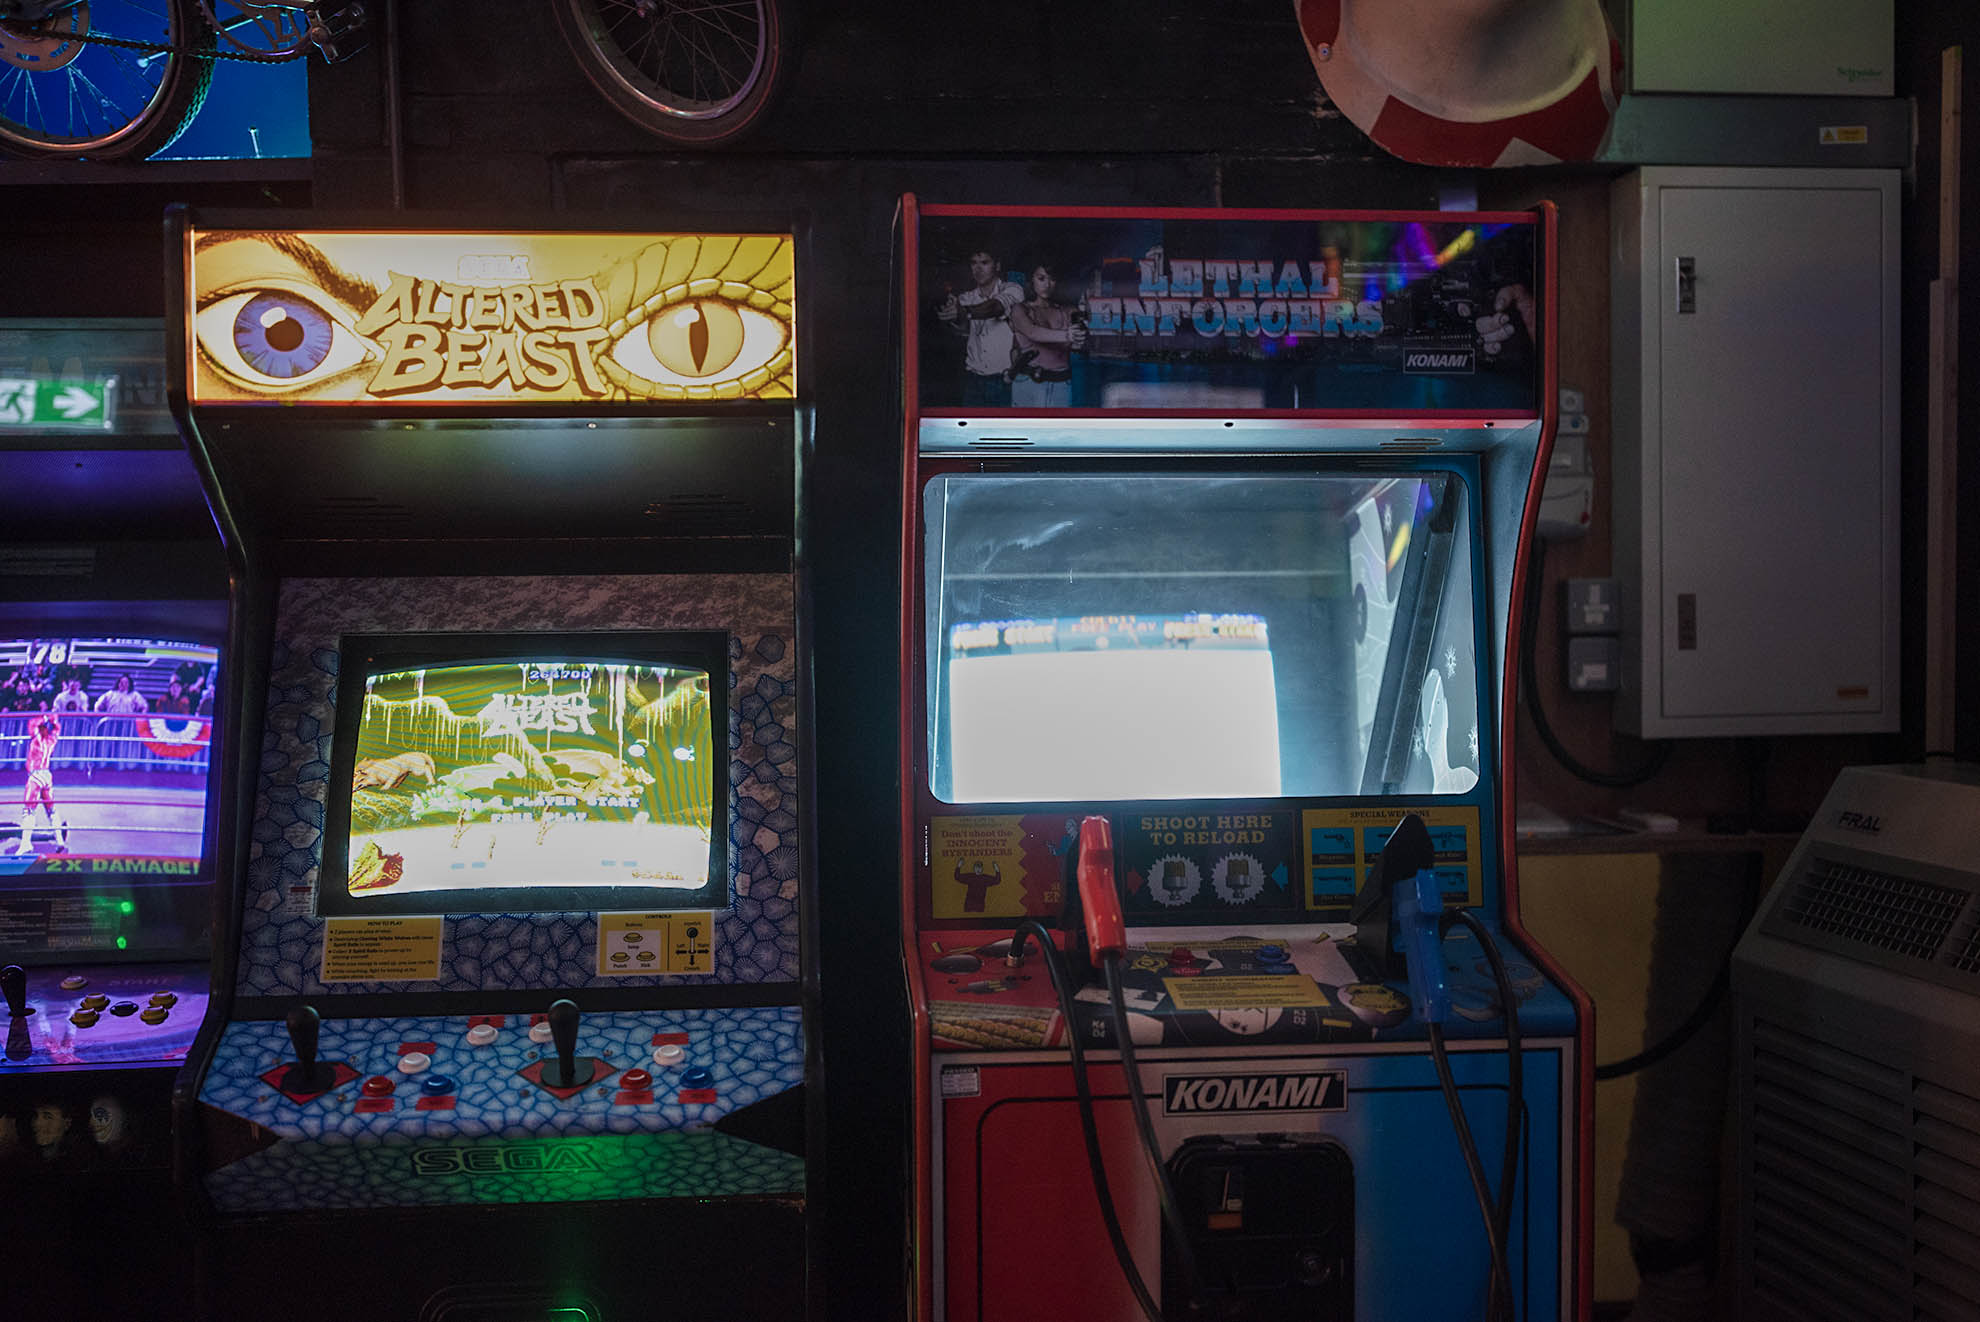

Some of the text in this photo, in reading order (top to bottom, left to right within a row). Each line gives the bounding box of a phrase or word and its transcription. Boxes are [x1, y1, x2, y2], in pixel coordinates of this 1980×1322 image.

[1138, 246, 1340, 299] LETHAL
[355, 270, 608, 336] ALTERED
[1086, 296, 1386, 339] ENFORCERS
[367, 326, 610, 398] BEAST
[1406, 353, 1469, 368] KONAMI
[34, 642, 67, 665] 78
[512, 796, 577, 809] PLAYER
[587, 796, 641, 808] START
[1140, 814, 1273, 831] SHOOT HERE
[1350, 809, 1387, 819] SPECIAL
[1839, 811, 1881, 832] FRAL
[941, 830, 968, 839] Don't
[969, 830, 996, 838] shoot
[1150, 830, 1265, 846] TO RELOAD
[946, 839, 1008, 849] INNOCENT
[941, 848, 1013, 858] BYSTANDERS
[92, 860, 200, 874] DAMAGE!
[1170, 1075, 1330, 1110] KONAMI
[412, 1142, 603, 1177] SEGA
